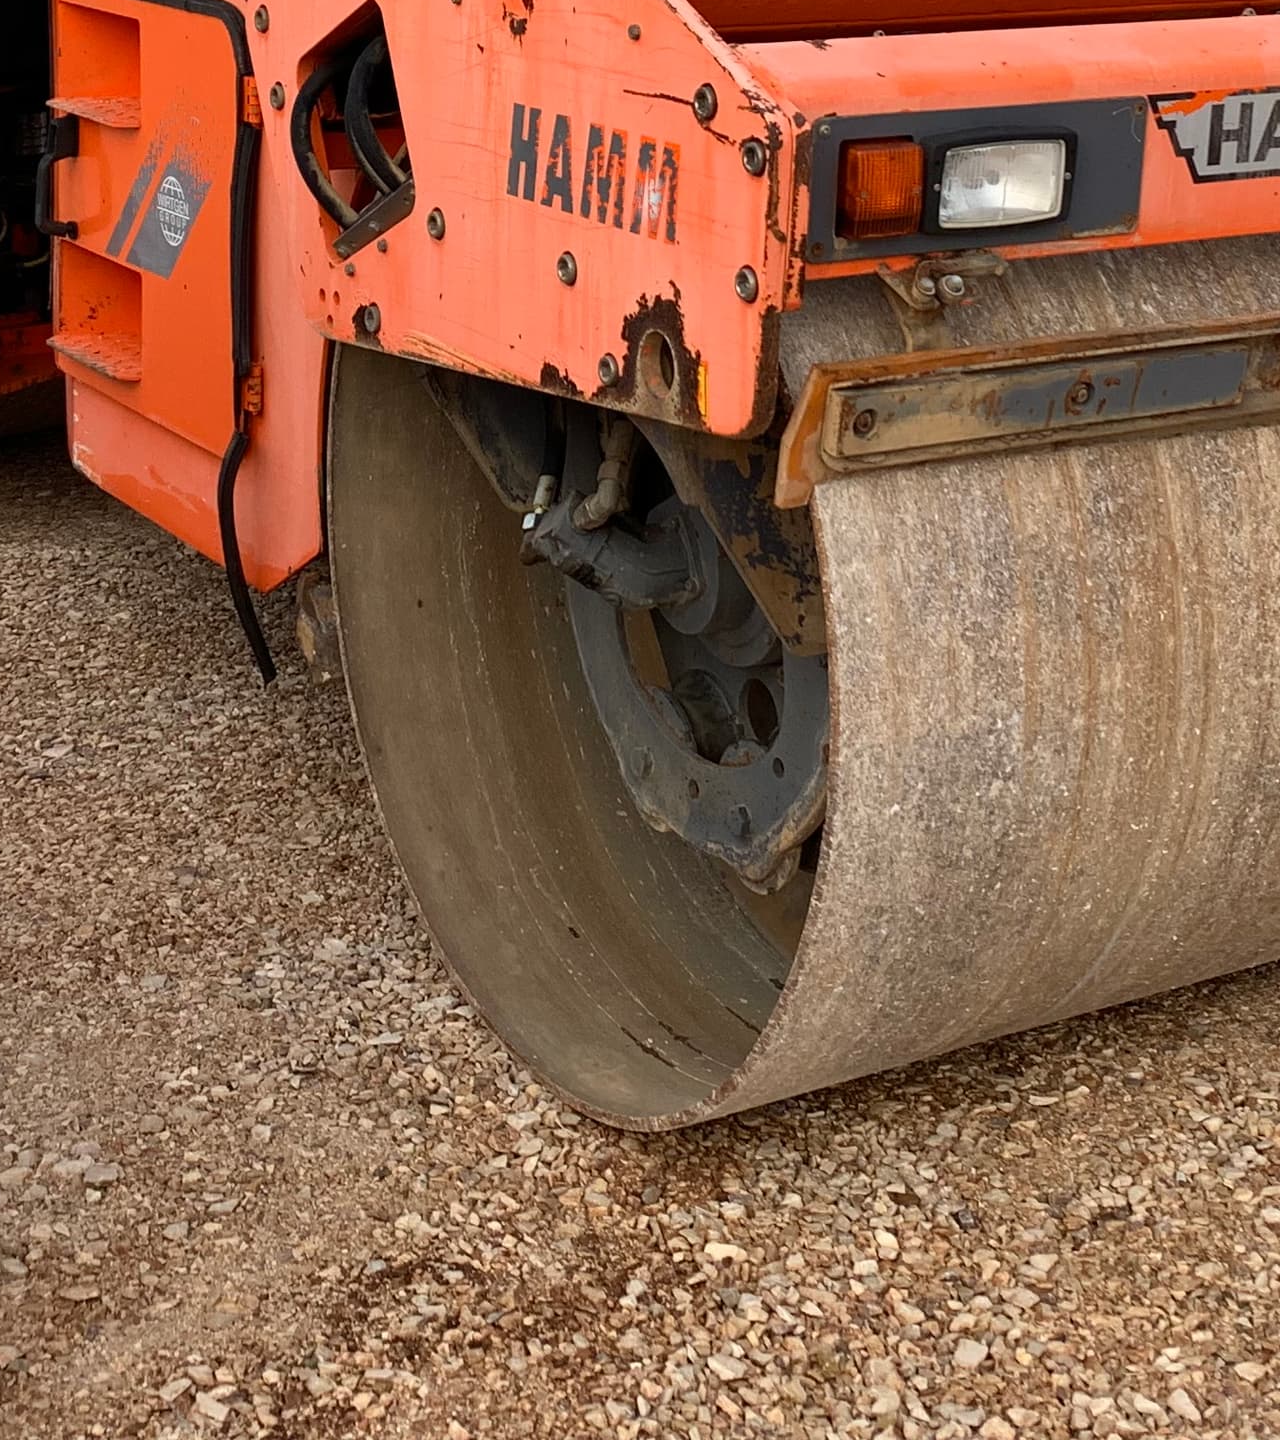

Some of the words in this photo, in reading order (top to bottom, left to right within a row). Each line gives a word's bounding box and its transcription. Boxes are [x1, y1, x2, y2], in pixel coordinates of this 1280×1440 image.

[506, 102, 681, 245] HAMM
[157, 192, 189, 216] WIRTGEN
[160, 210, 187, 229] GROUP
